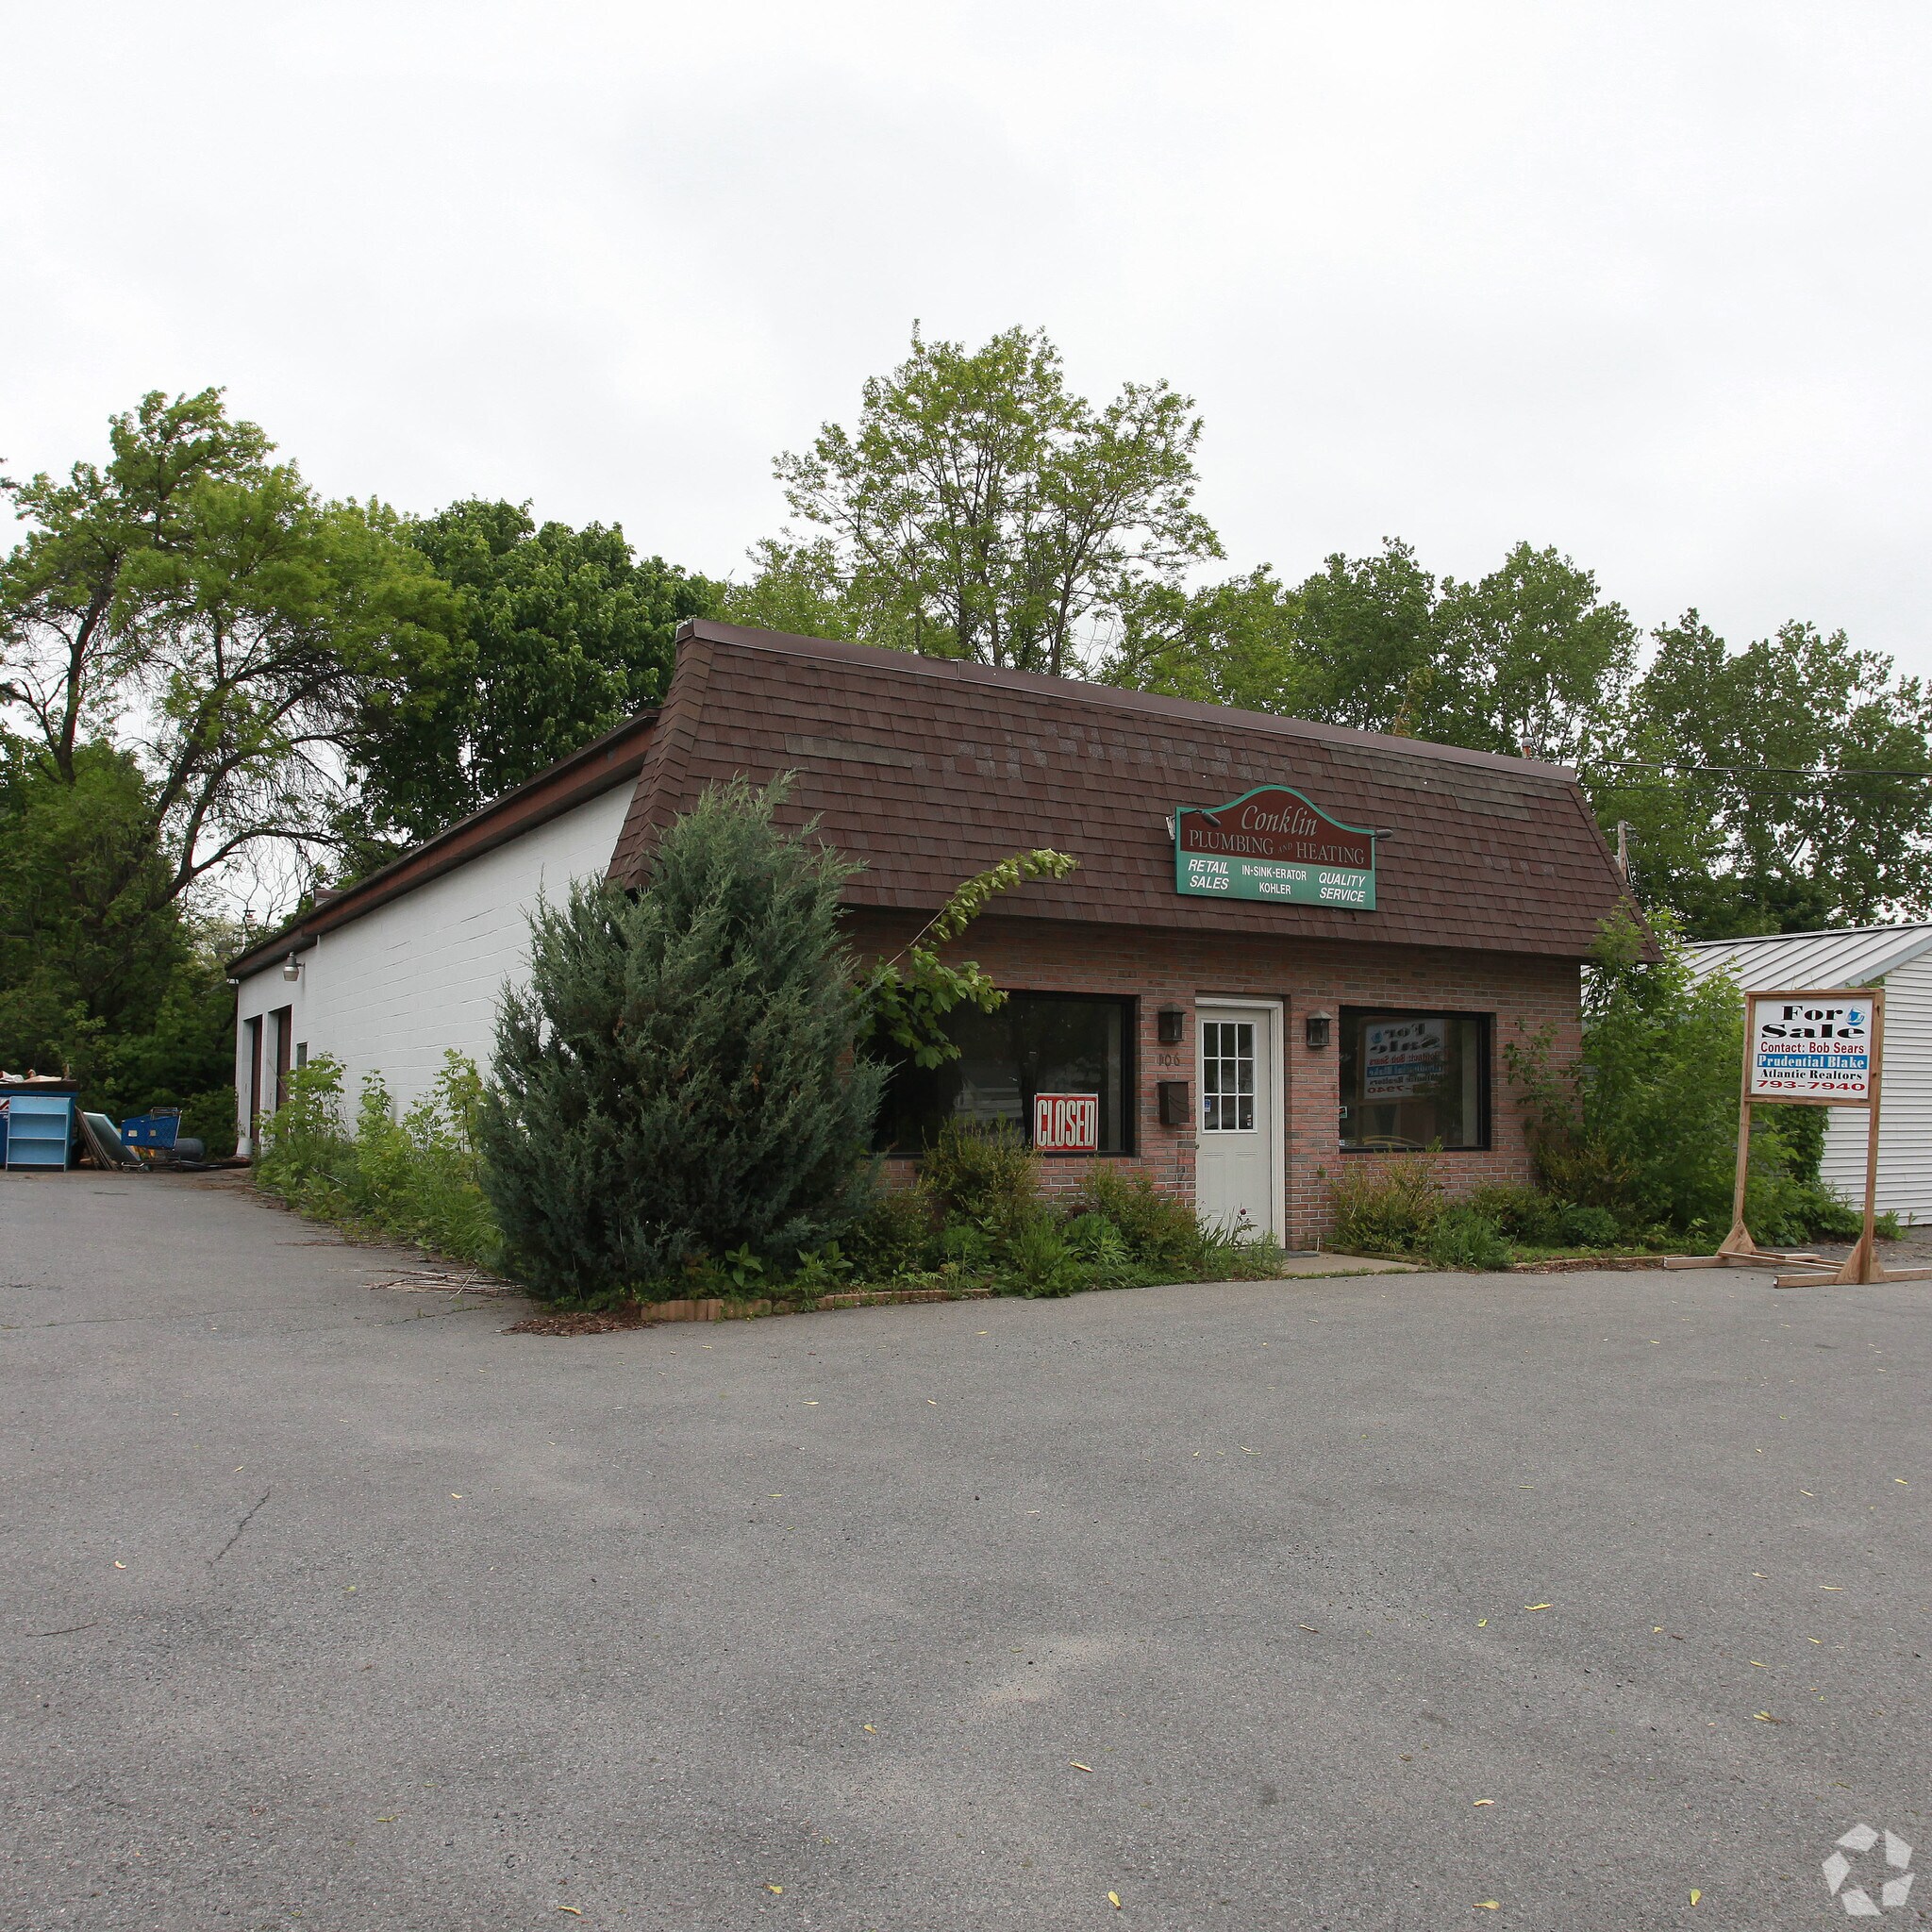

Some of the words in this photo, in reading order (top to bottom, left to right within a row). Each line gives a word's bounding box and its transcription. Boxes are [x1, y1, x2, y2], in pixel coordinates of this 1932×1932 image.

[1241, 805, 1317, 836] Conklin
[1189, 829, 1274, 855] PLUMBING
[1278, 842, 1293, 854] AND
[1296, 841, 1365, 865] HEATING
[1188, 858, 1229, 874] RETAIL
[1241, 864, 1307, 881] IN-SINK-ERATOR
[1189, 874, 1230, 891] SALES
[1258, 881, 1291, 895] KOHLER
[1318, 872, 1366, 888] QUALITY
[1319, 887, 1365, 903] SERVICE
[1781, 1006, 1843, 1021] For
[1761, 1024, 1865, 1039] Sale
[1760, 1041, 1806, 1054] Contact:
[1808, 1041, 1830, 1054] Bob
[1833, 1041, 1865, 1055] Sears
[1757, 1055, 1824, 1068] Prudential
[1827, 1056, 1864, 1069] Blake
[1760, 1068, 1807, 1080] Atlantic
[1809, 1069, 1863, 1081] Realtors
[1757, 1080, 1865, 1091] 793-7940
[1037, 1099, 1095, 1147] CLOSED
